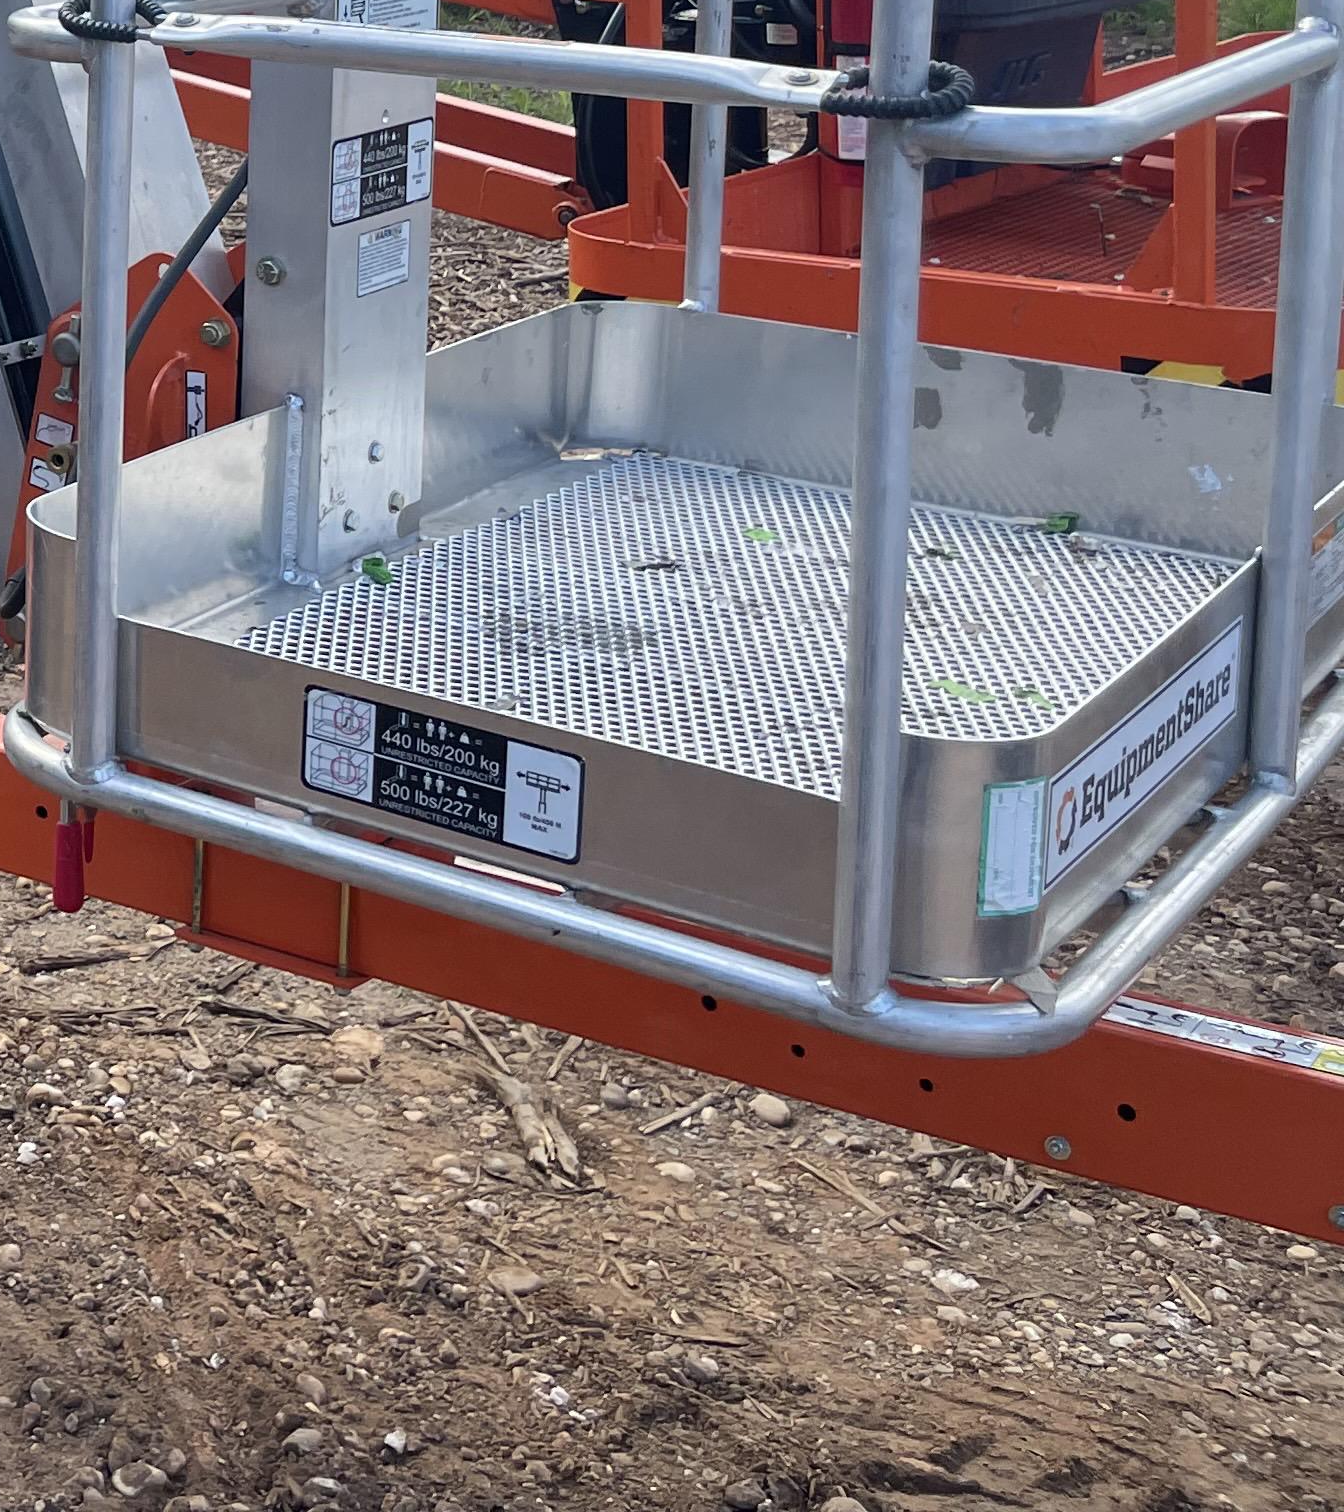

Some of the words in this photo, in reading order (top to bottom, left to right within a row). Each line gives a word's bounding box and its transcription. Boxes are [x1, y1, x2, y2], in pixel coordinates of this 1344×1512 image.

[362, 192, 374, 206] 500
[381, 729, 412, 748] 440
[416, 737, 475, 767] lbs/200
[480, 755, 500, 777] kg
[381, 746, 451, 772] UNRESTRICTED
[454, 766, 500, 785] CAPACITY
[1079, 663, 1232, 829] EquipmentShare
[378, 798, 450, 825] UNRESTRICTED
[451, 819, 498, 838] CAPACITY
[380, 780, 410, 801] 500
[414, 790, 474, 818] lbs/227
[478, 807, 498, 829] kg
